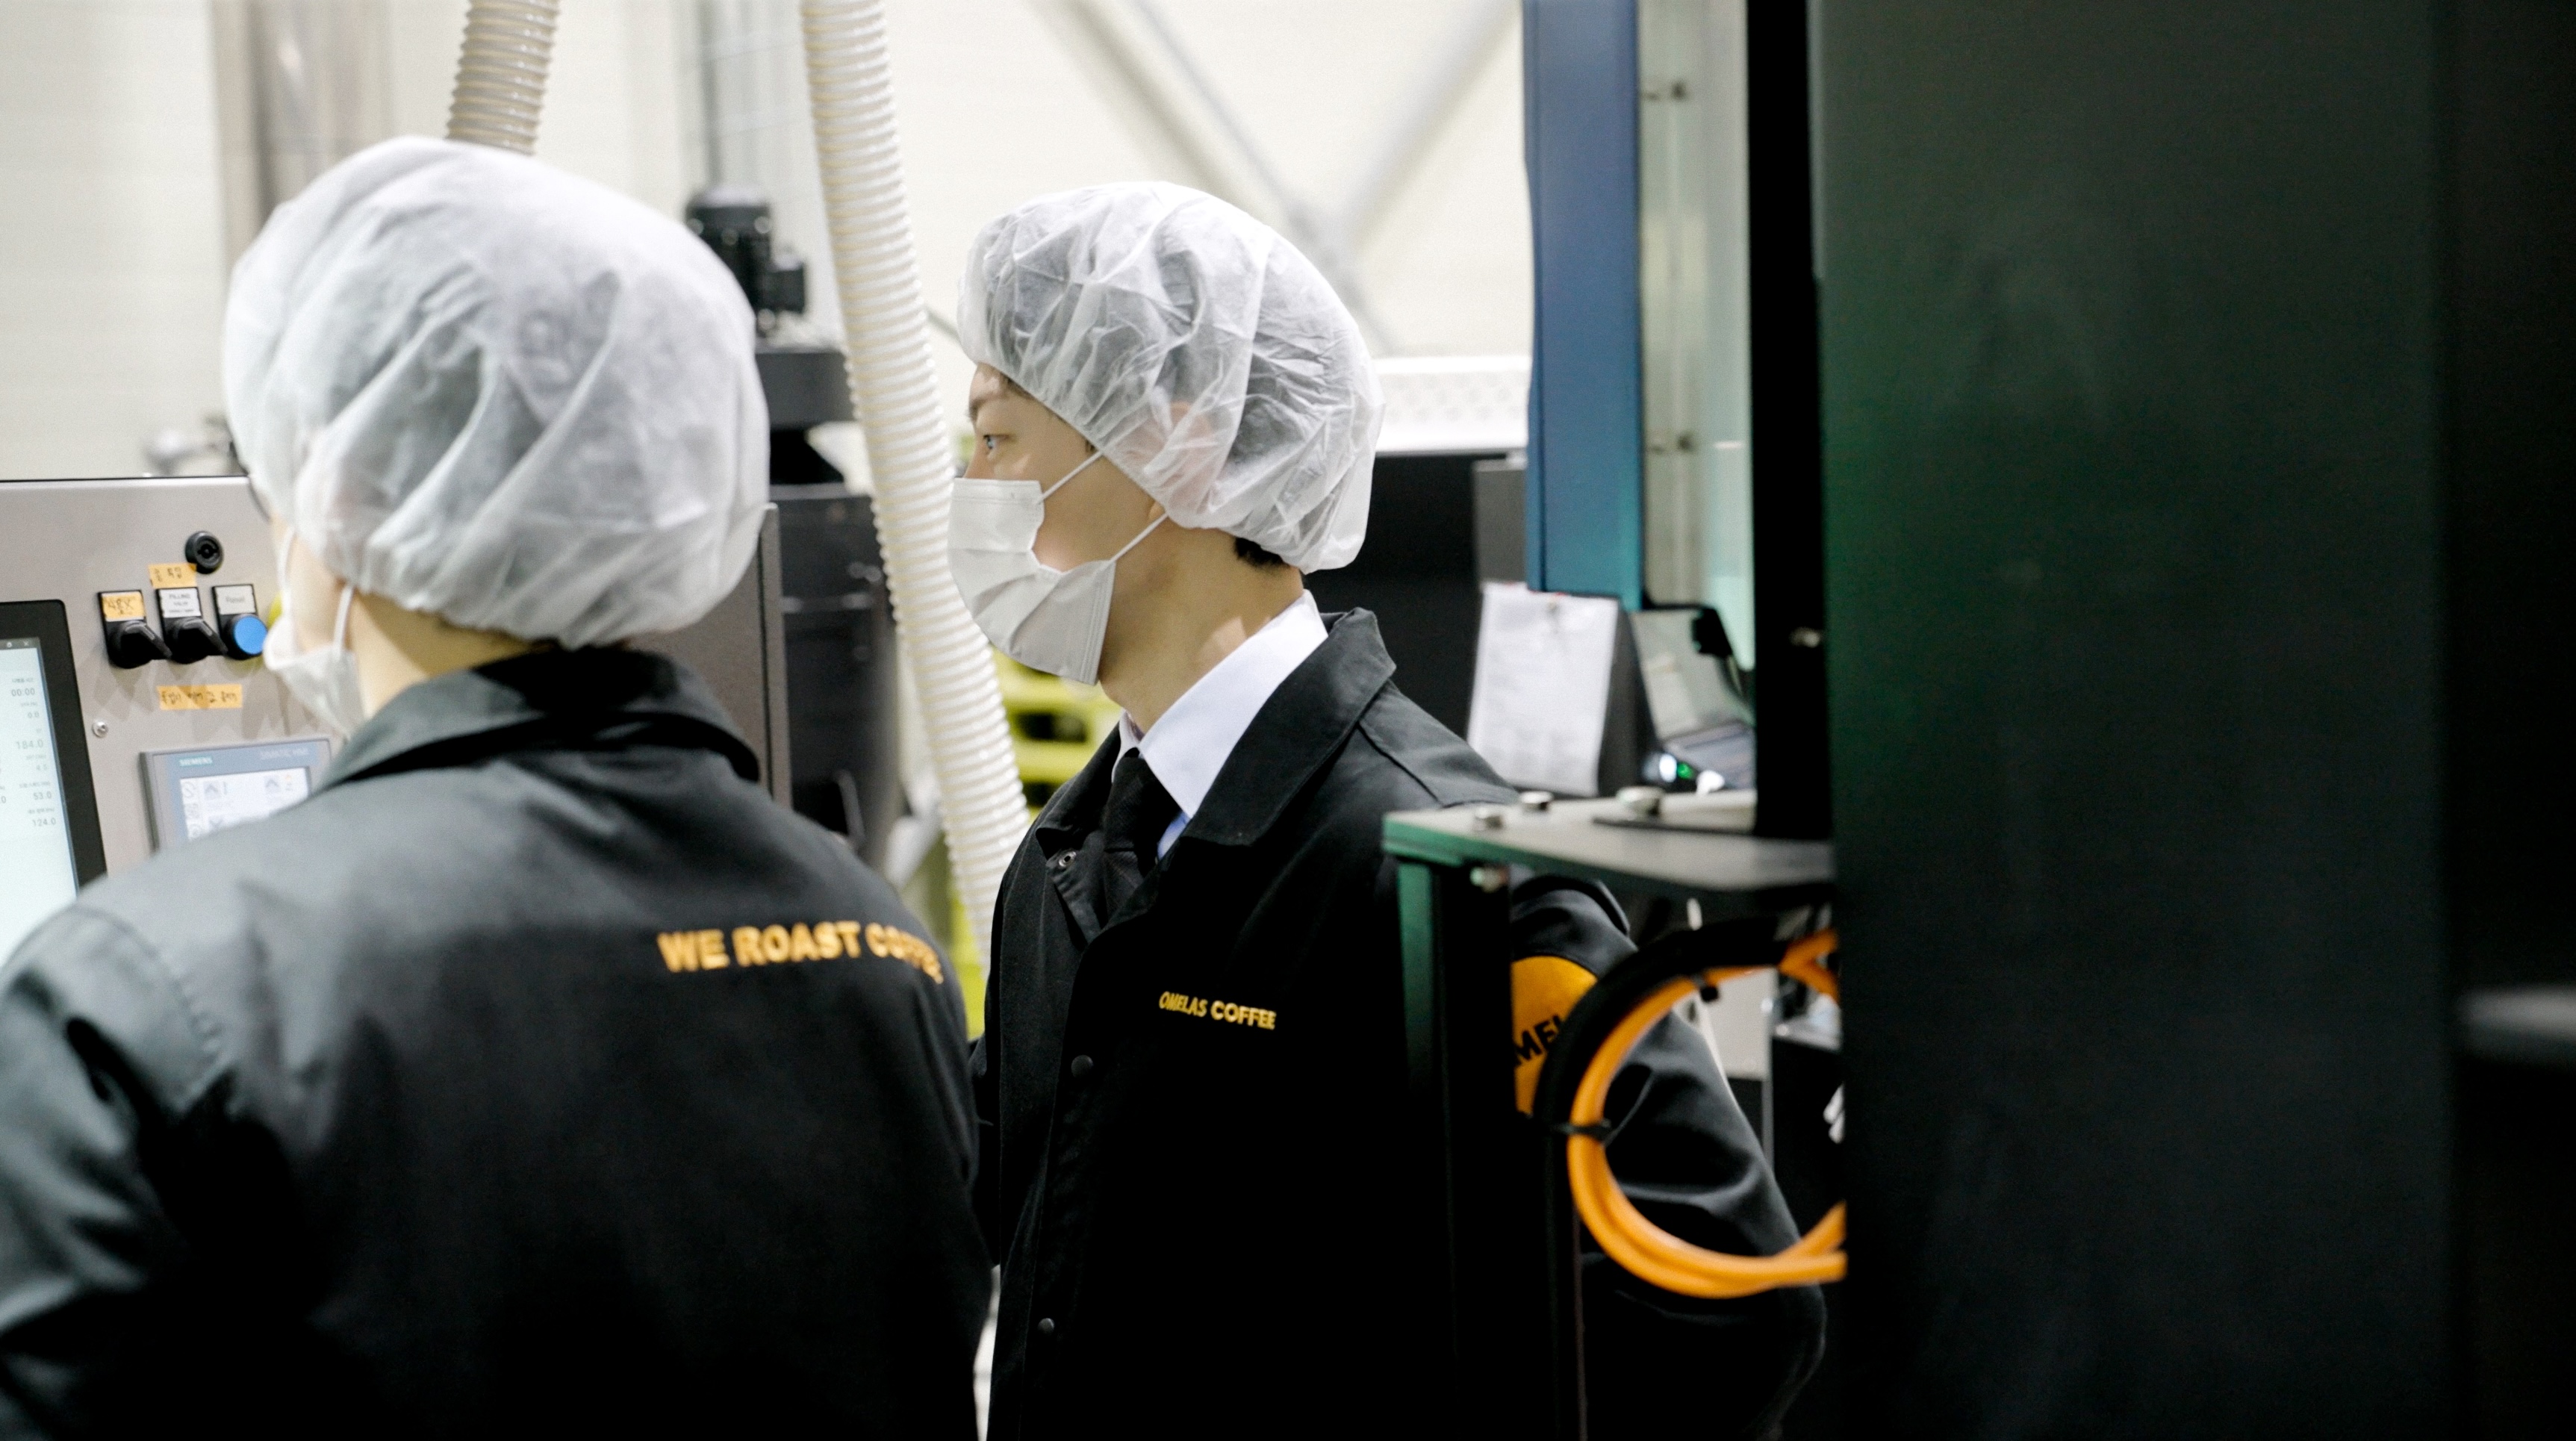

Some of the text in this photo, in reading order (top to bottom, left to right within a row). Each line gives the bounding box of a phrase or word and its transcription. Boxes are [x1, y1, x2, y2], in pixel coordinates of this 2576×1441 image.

[16, 739, 44, 750] 184.0
[32, 818, 57, 827] 124.0
[657, 929, 730, 972] WE
[732, 921, 861, 967] ROAST
[1159, 991, 1277, 1030] OMELAS COFFEE
